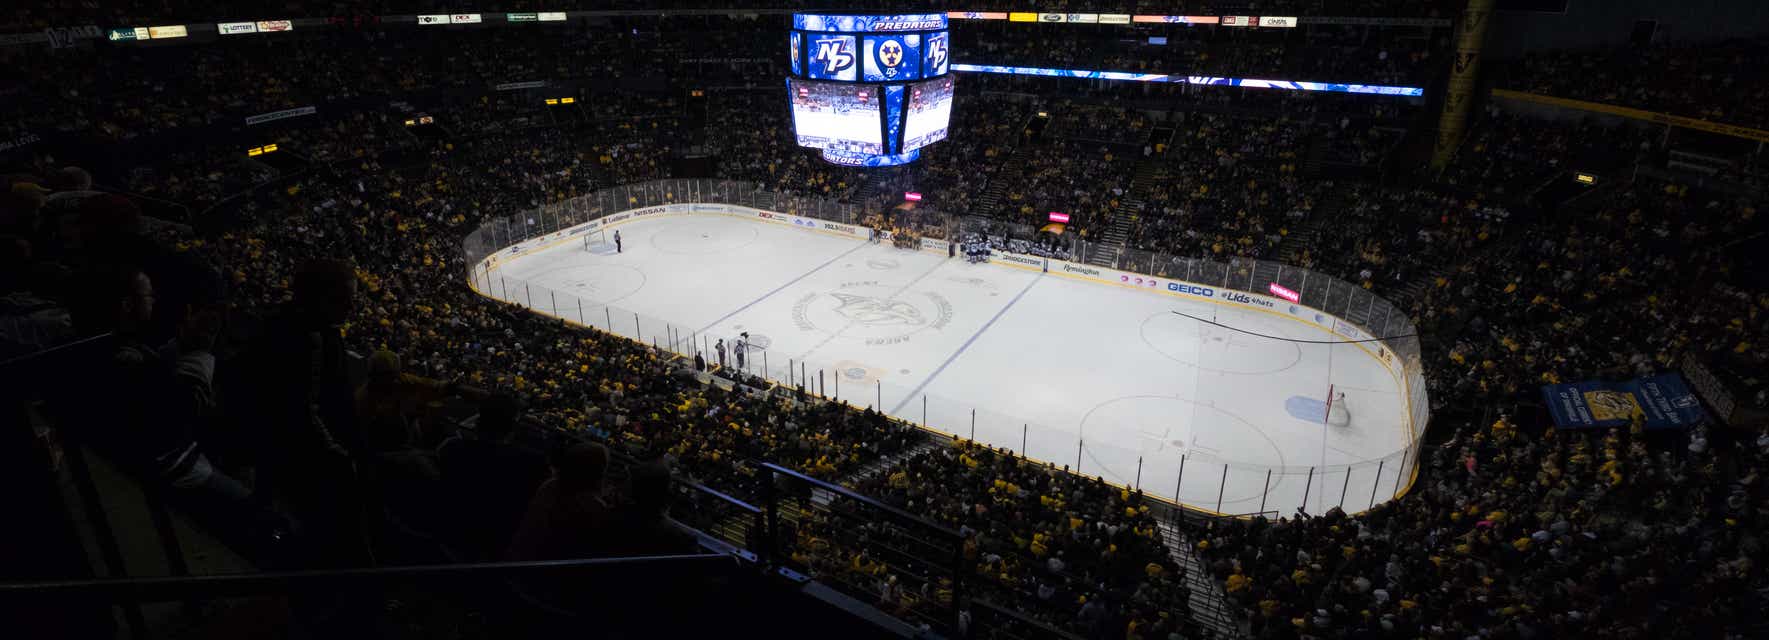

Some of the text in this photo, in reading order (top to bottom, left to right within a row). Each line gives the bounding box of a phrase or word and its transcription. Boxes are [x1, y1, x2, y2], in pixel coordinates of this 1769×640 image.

[875, 20, 942, 30] PREDATORS
[634, 207, 666, 217] NISSAN
[1168, 282, 1214, 297] GEICO
